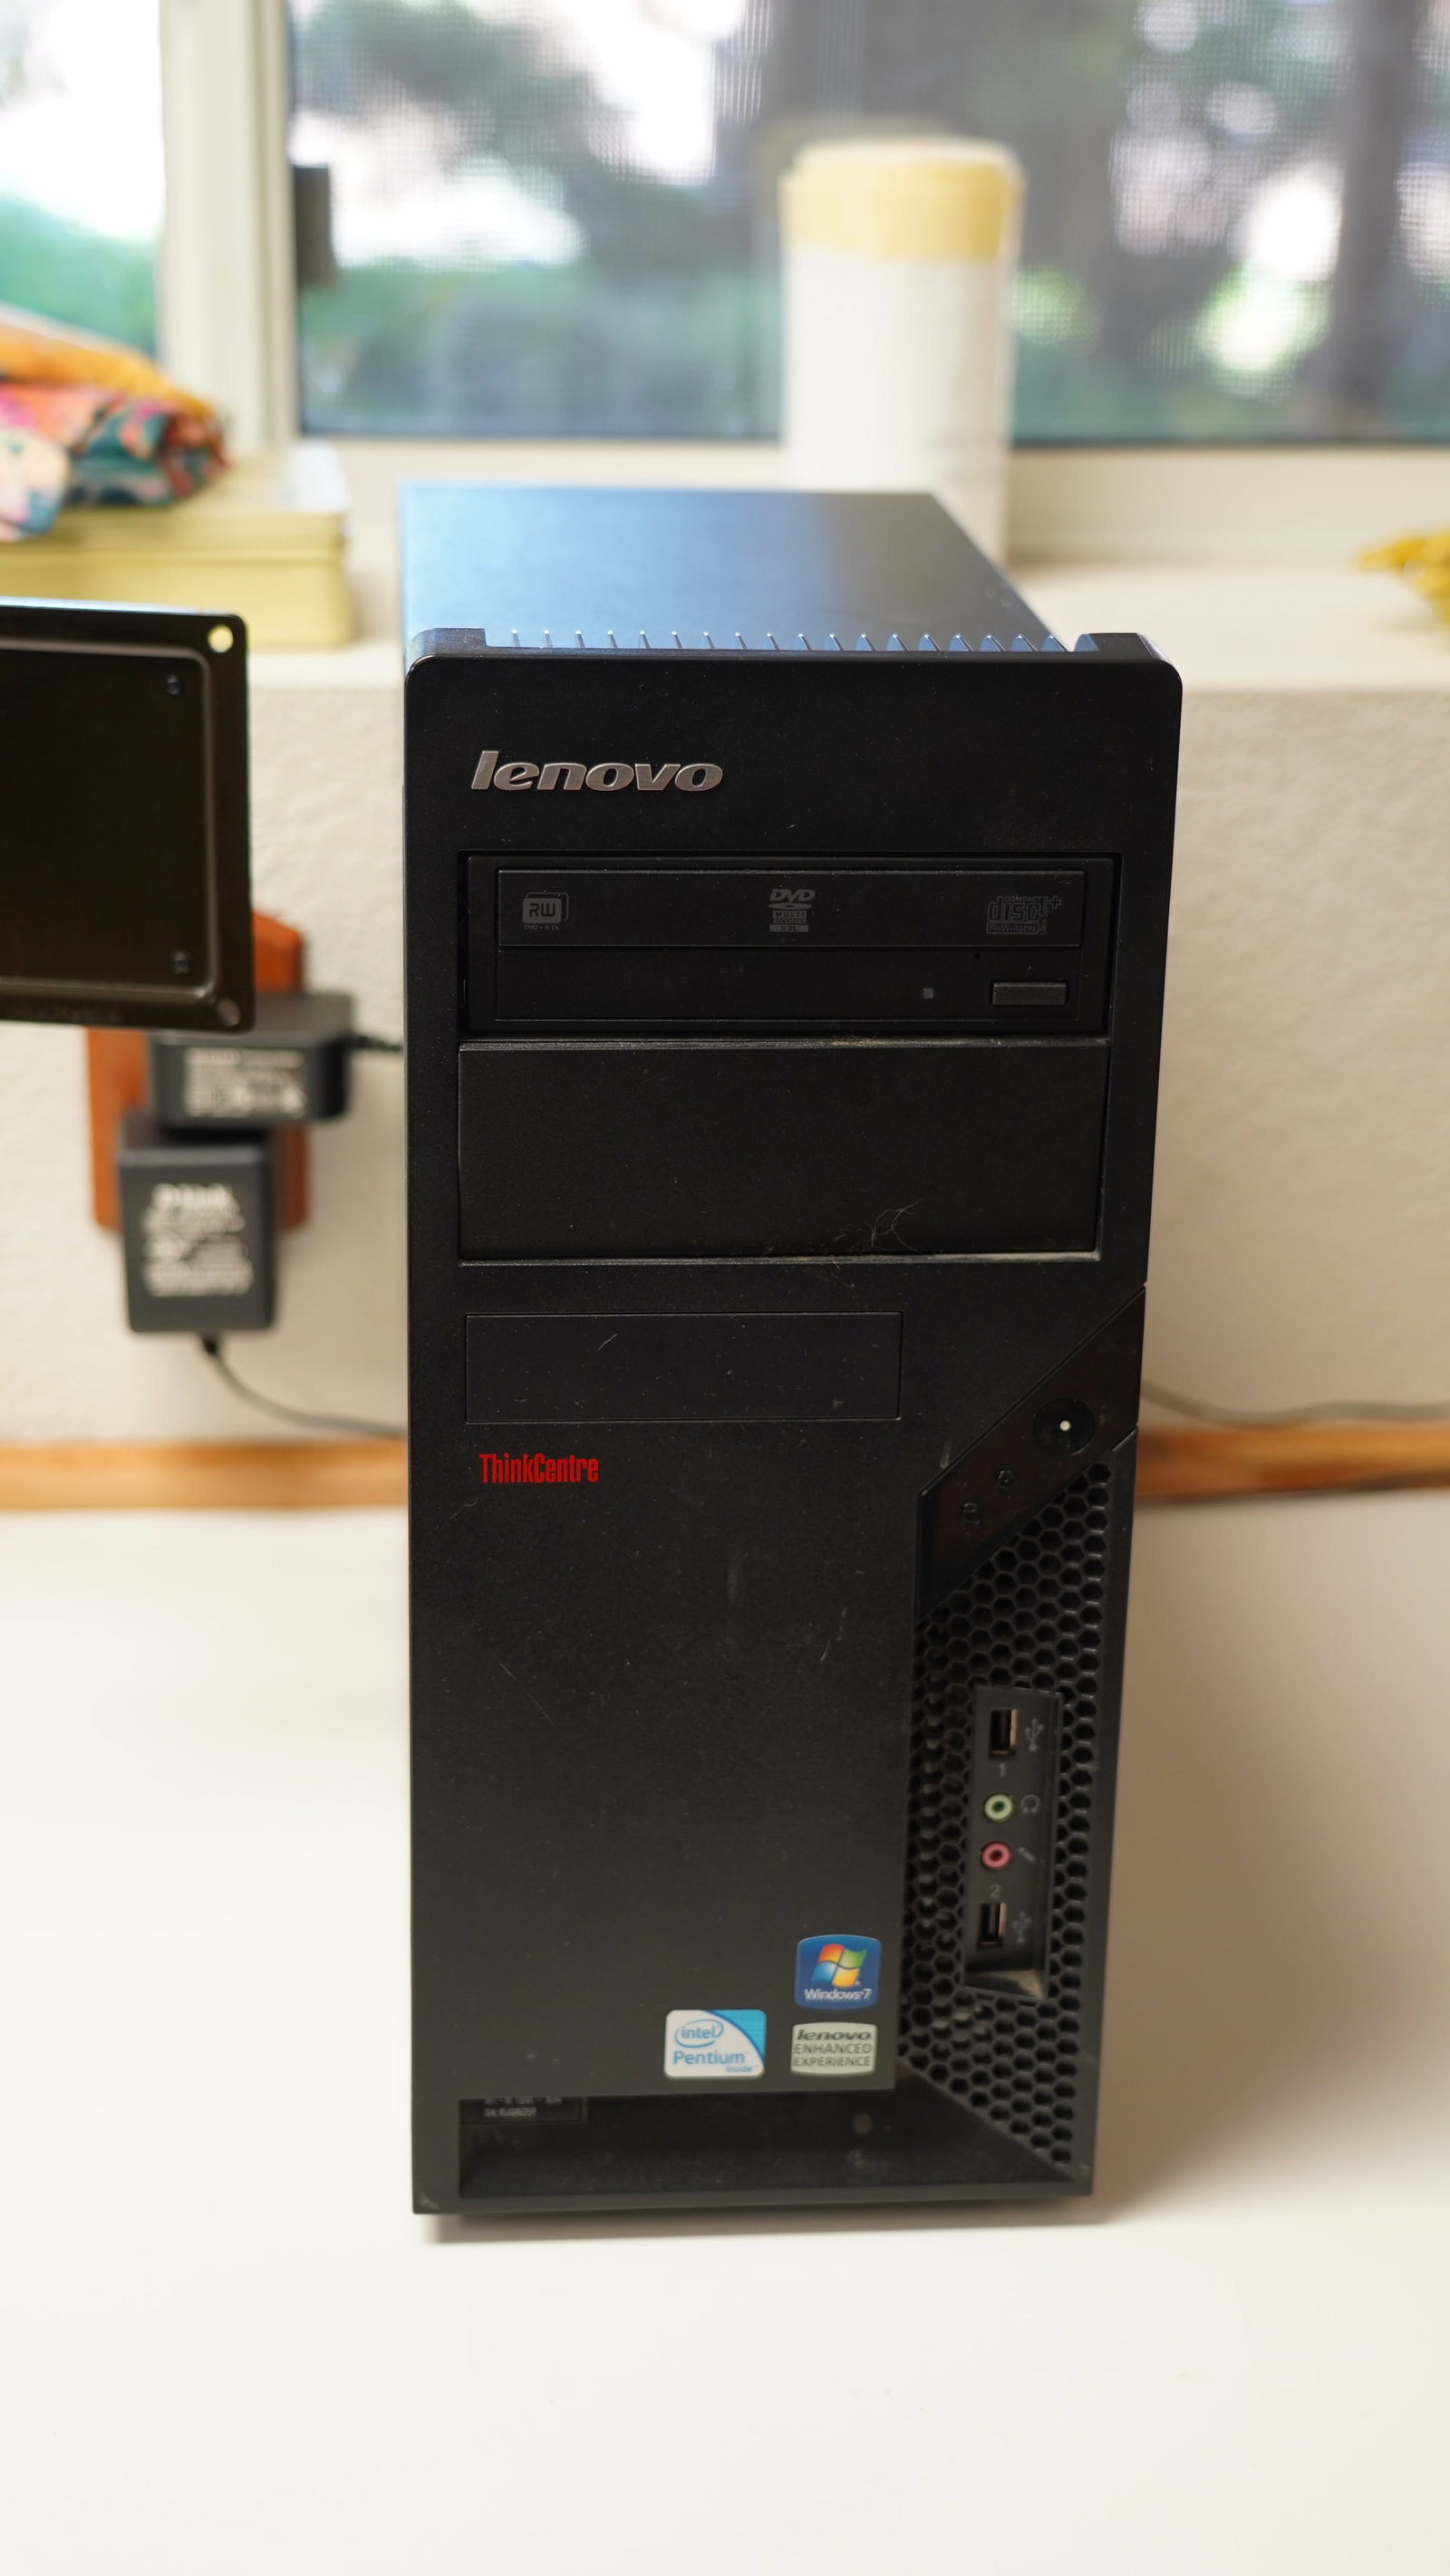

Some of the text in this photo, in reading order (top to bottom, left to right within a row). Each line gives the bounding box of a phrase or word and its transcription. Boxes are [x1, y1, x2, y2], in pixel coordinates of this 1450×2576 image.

[471, 750, 723, 791] lenovo
[769, 889, 816, 902] DVD
[529, 902, 556, 917] RW
[987, 896, 1041, 921] disc
[478, 1452, 599, 1483] ThinkCentre
[999, 1762, 1006, 1777] 1
[989, 1884, 1002, 1898] 2
[804, 1988, 860, 2001] Windows
[681, 2025, 716, 2039] intel
[797, 2029, 871, 2041] lenovo
[794, 2043, 872, 2054] ENHANCED
[672, 2050, 745, 2065] Pentium
[794, 2056, 871, 2068] EXPERIENCE
